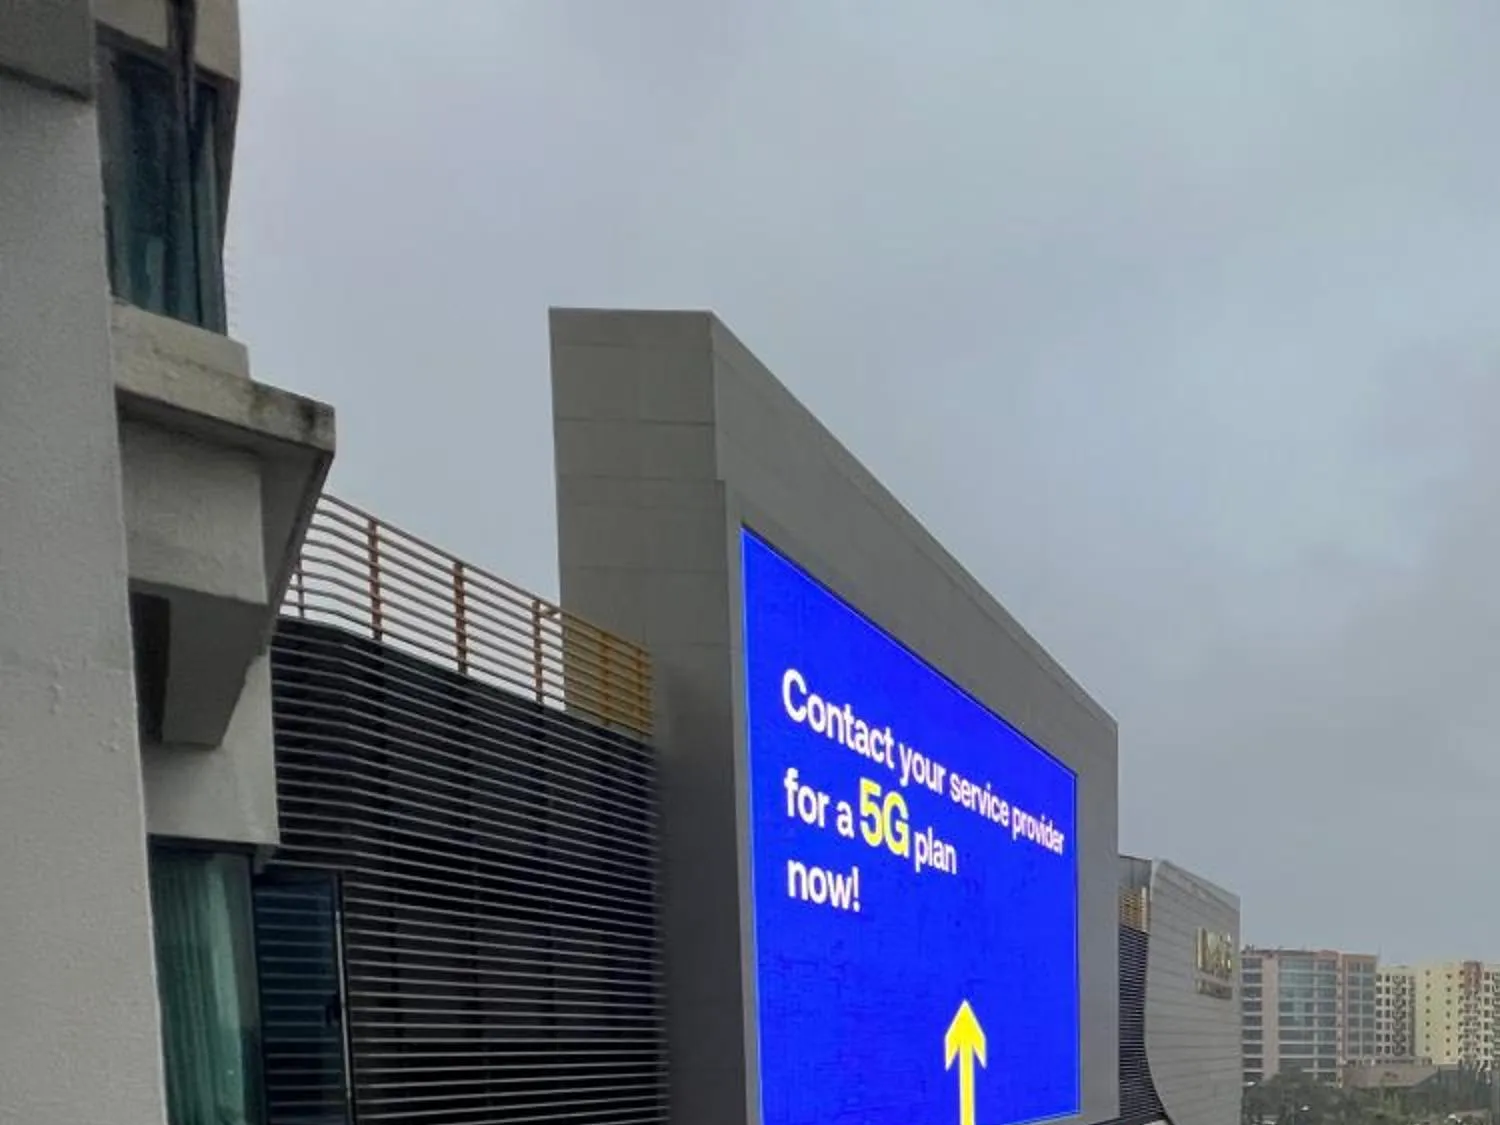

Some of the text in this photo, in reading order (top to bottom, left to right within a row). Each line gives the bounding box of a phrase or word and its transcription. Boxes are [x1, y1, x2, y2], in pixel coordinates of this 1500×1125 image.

[781, 668, 1065, 855] Contact your service provider
[783, 767, 957, 875] for a 5G plan
[787, 859, 861, 913] now!
